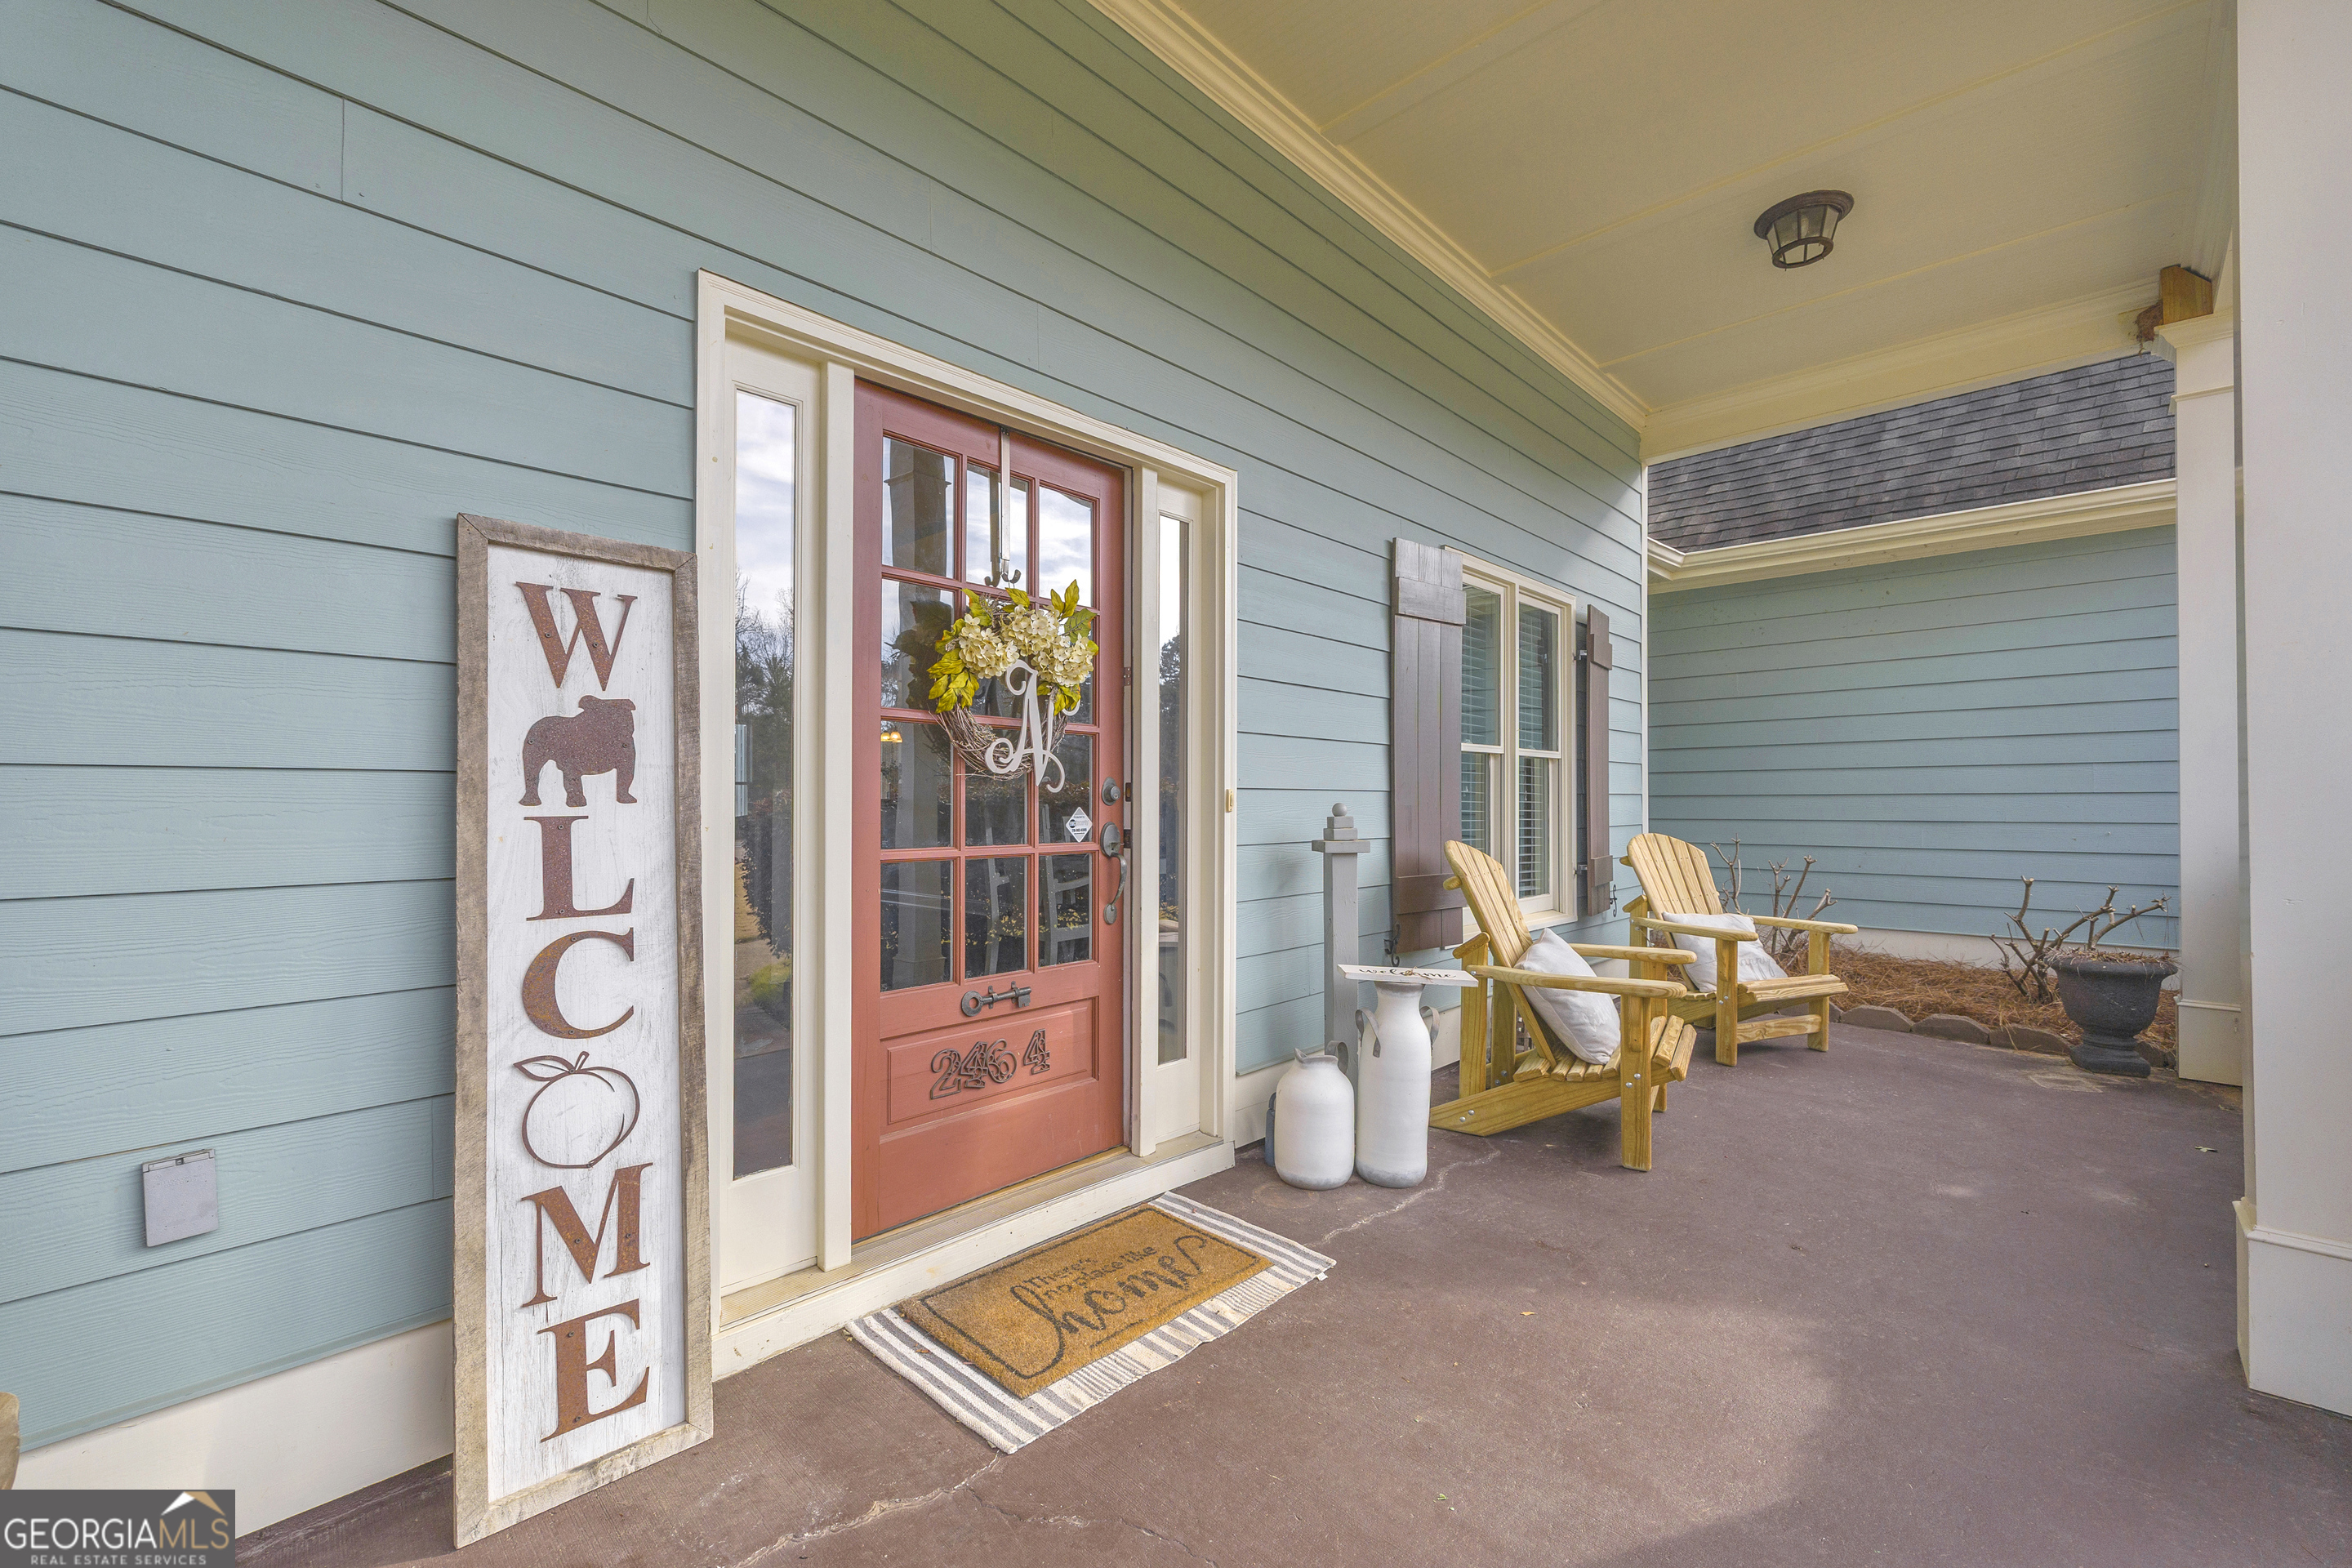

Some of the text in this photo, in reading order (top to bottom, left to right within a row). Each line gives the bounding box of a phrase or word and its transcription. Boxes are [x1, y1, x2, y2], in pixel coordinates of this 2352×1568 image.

[1358, 969, 1457, 978] welcme
[1738, 956, 1775, 980] appy
[1009, 1234, 1208, 1348] home
[1042, 1284, 1073, 1300] no
[1119, 1245, 1157, 1264] like
